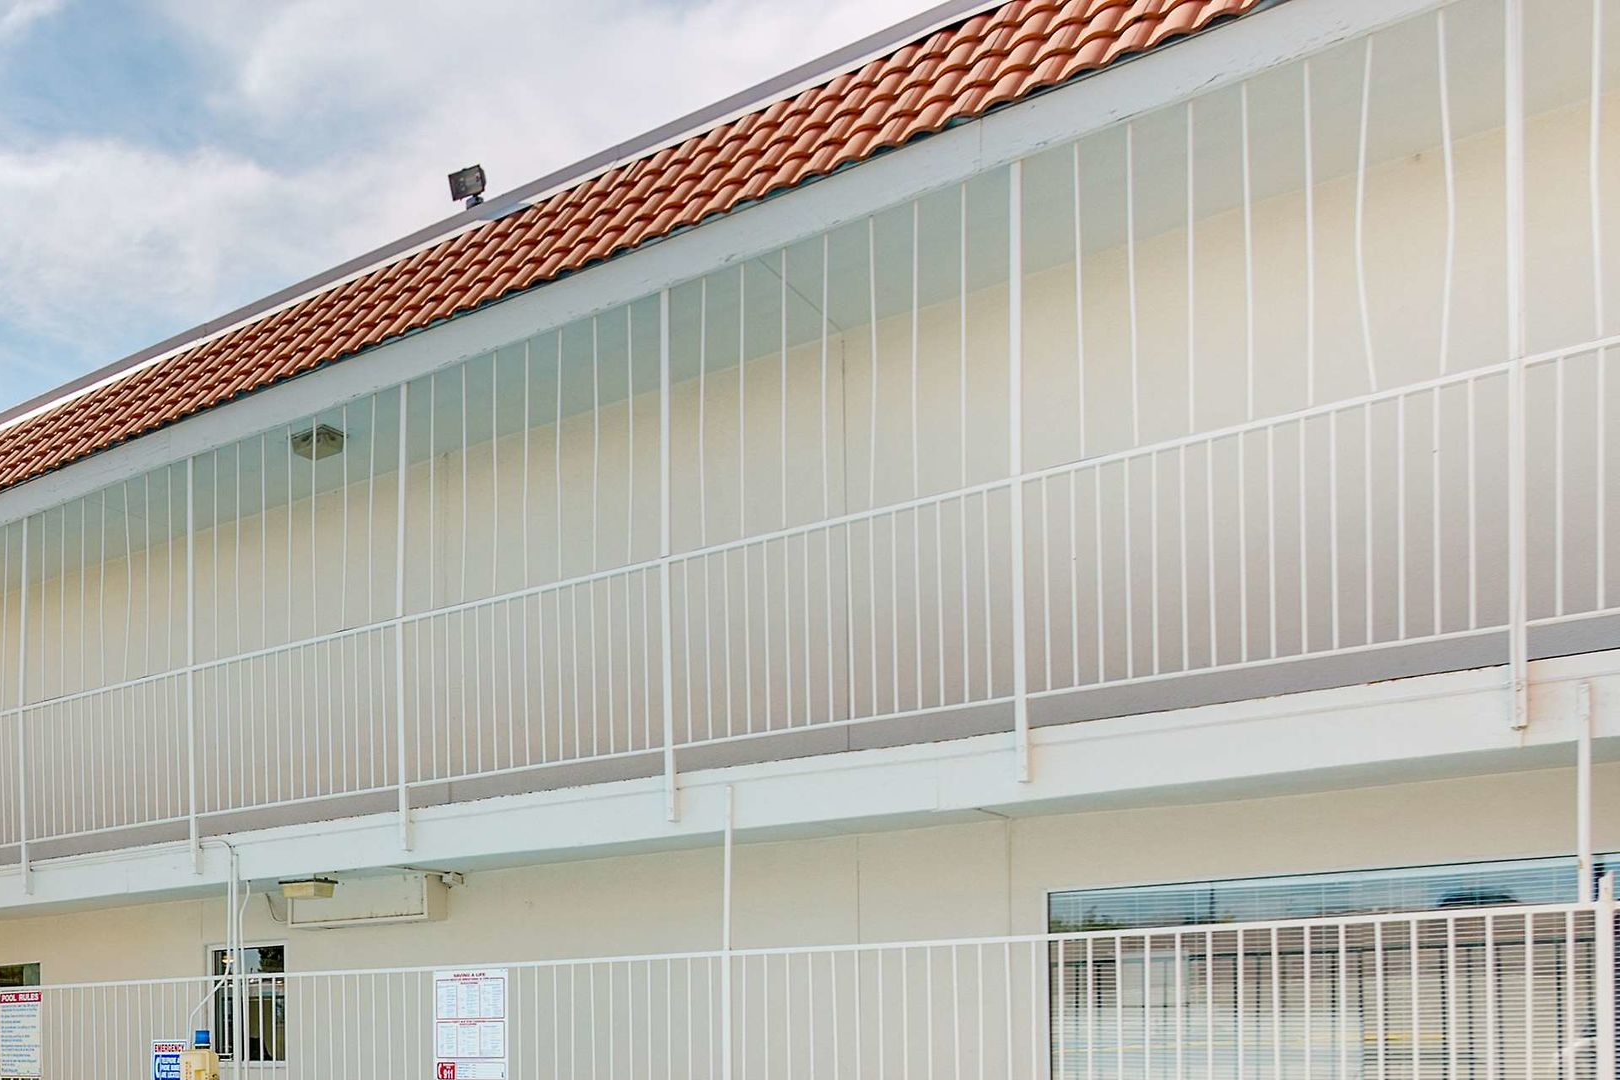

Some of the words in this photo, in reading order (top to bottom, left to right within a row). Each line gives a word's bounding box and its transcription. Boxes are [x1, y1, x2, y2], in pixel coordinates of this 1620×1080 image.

[1, 993, 17, 1002] POOL
[18, 992, 39, 1001] RULES
[154, 1044, 185, 1052] EMERGENCY
[443, 1070, 454, 1080] 911
